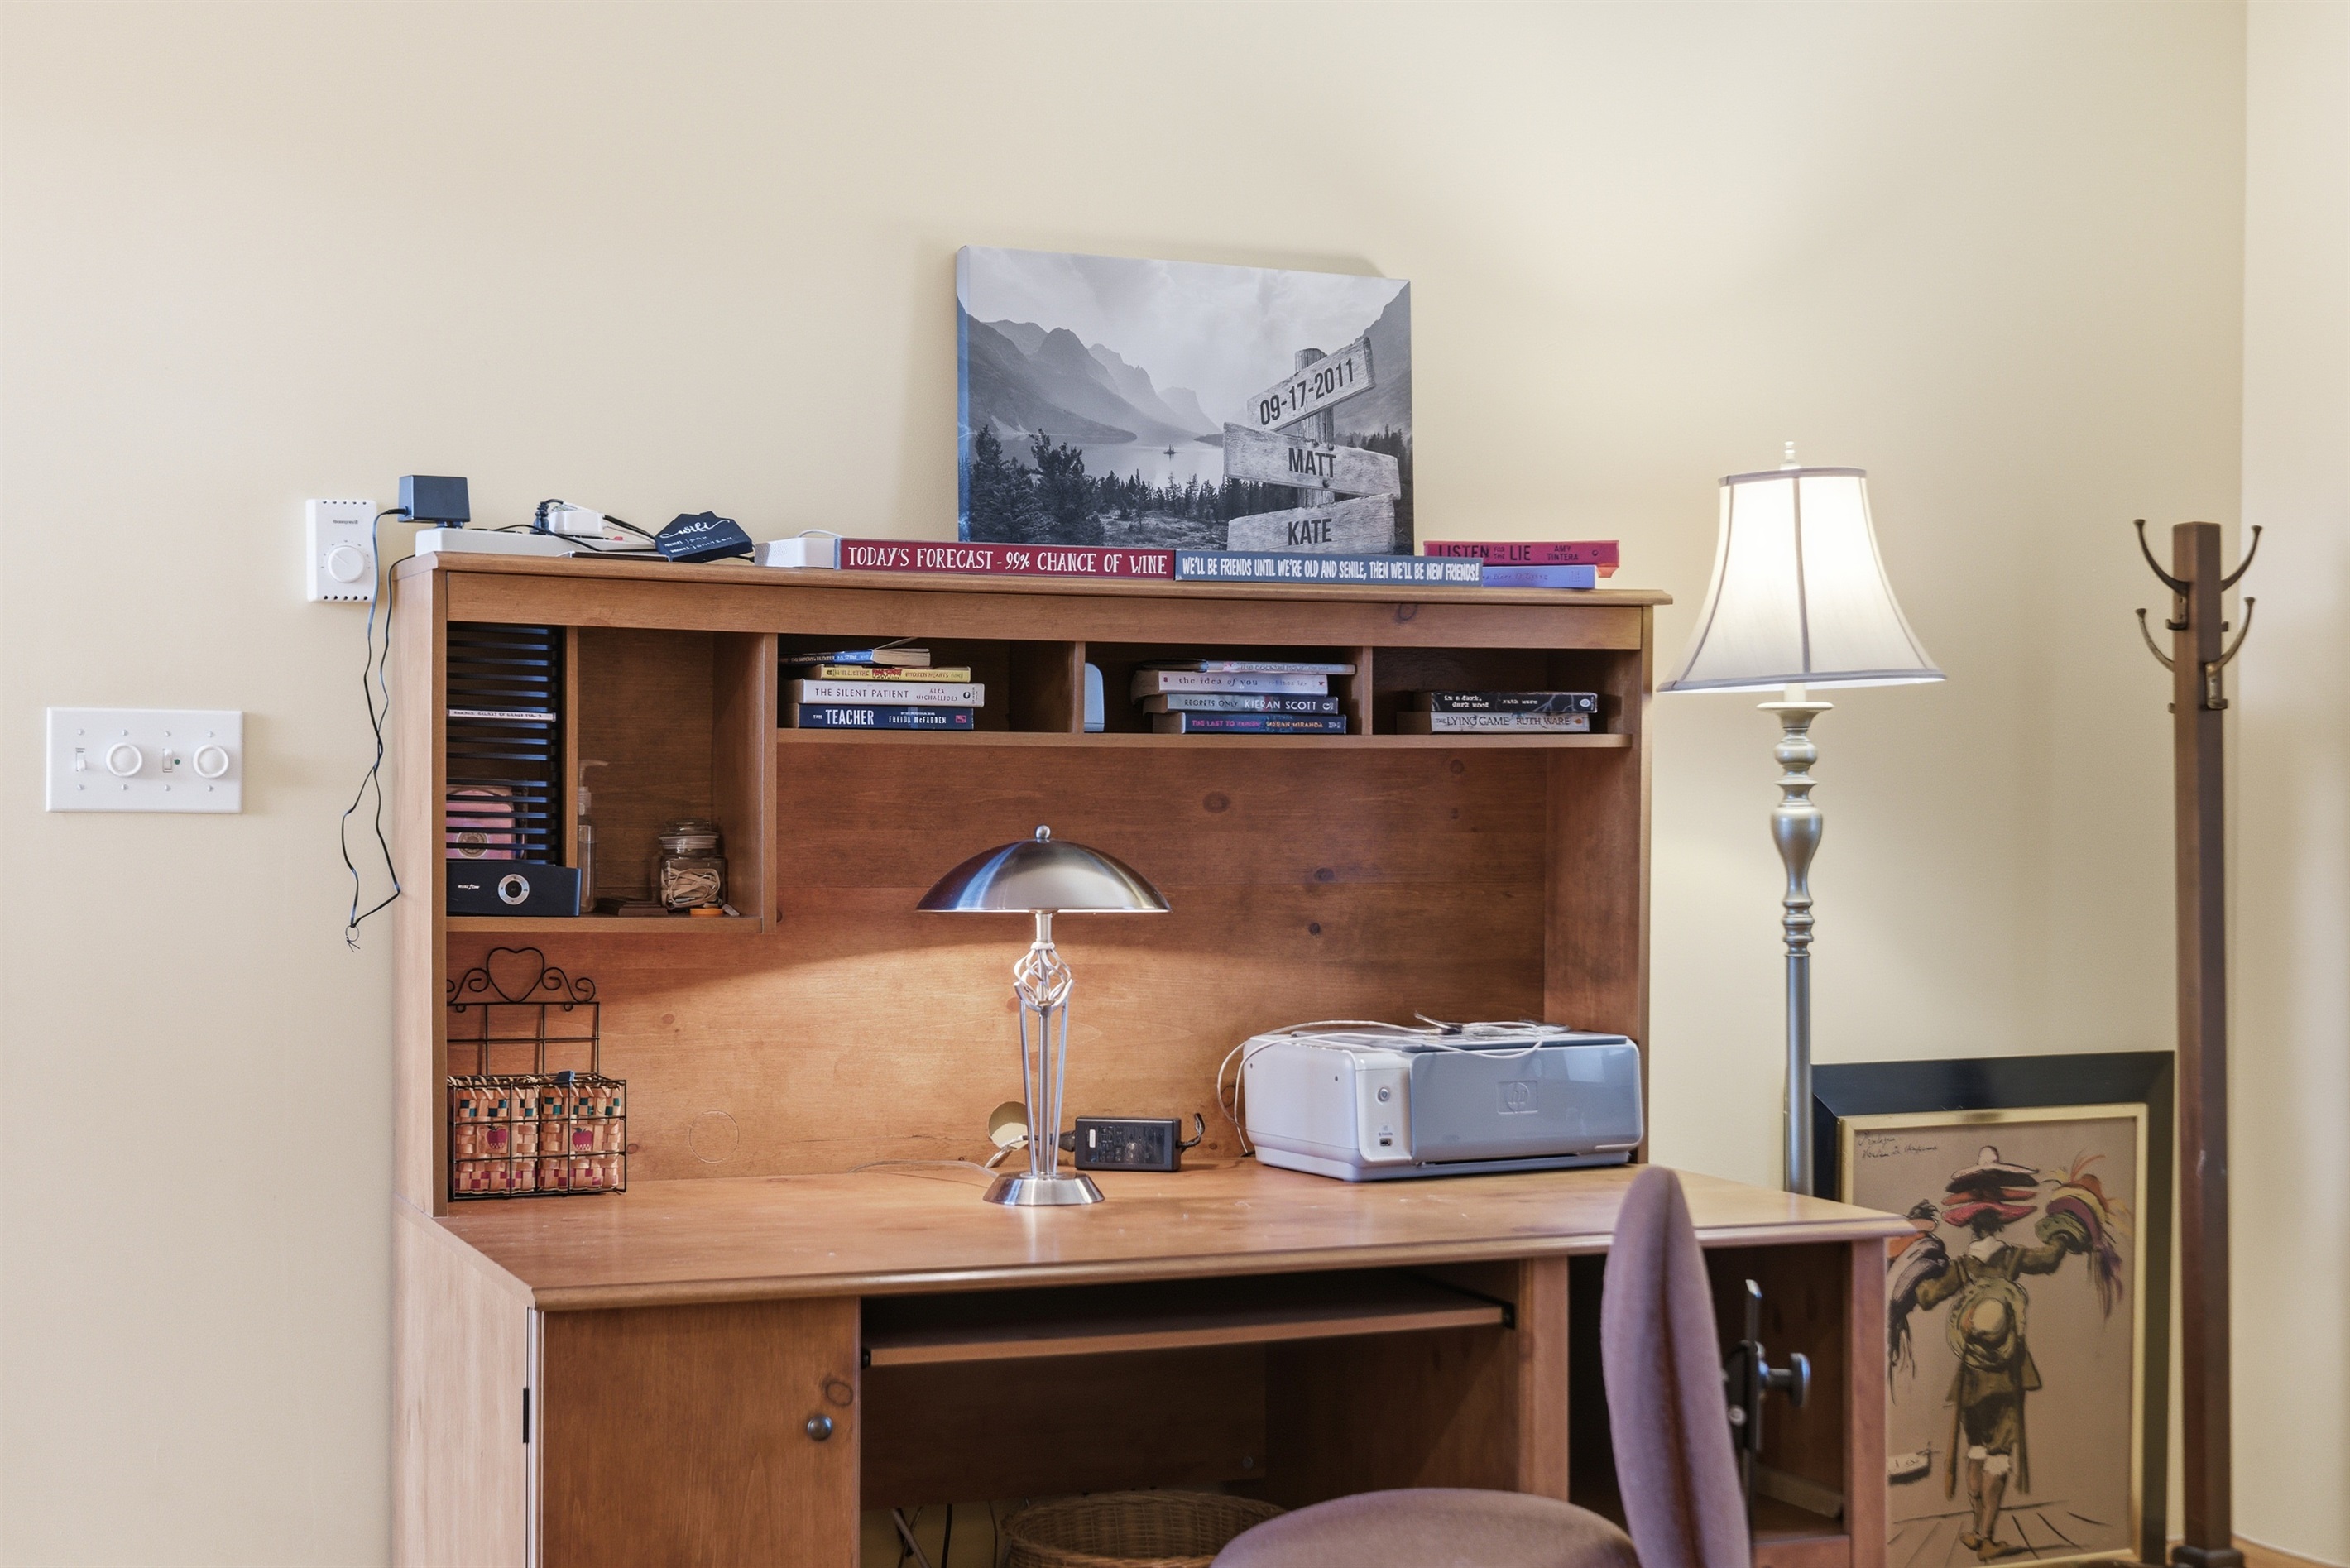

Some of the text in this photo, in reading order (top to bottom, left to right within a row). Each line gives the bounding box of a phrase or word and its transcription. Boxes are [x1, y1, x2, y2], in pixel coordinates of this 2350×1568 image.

[1259, 357, 1354, 425] 09-17-2011
[1288, 447, 1336, 478] MATT
[1288, 518, 1332, 546] KATE
[848, 546, 909, 567] TODAY'S
[916, 547, 994, 569] FORECAST
[1005, 551, 1030, 570] 99%
[1036, 552, 1096, 573] CHANCE
[1103, 554, 1122, 573] OF
[1129, 555, 1168, 574] WINE
[1438, 545, 1489, 558] LISTEN
[1510, 545, 1532, 561] LIE
[1182, 556, 1206, 575] WE'LL
[1207, 558, 1217, 575] BE
[1221, 558, 1252, 576] FRIENDS
[1254, 559, 1276, 577] UNTIL
[1278, 559, 1302, 578] WE'RE
[1304, 559, 1318, 578] OLD
[1321, 560, 1337, 578] AND
[1339, 560, 1367, 580] SENILE,
[1369, 561, 1388, 579] THEN
[1390, 562, 1412, 579] WE'LL
[1414, 563, 1424, 580] BE
[1426, 563, 1444, 581] NEW
[1445, 563, 1480, 582] FRIENDS!
[1200, 677, 1222, 685] idea
[1226, 678, 1238, 688] of
[1240, 679, 1259, 688] you
[815, 688, 909, 698] THE SILENT PATIENT
[1244, 699, 1316, 710] KIERAN SCOTT
[825, 709, 875, 726] TEACHER
[888, 715, 947, 725] FREIDA McFADDEN
[1446, 716, 1477, 726] LYING
[1479, 716, 1509, 726] GAME
[1516, 717, 1571, 725] RUTH WARE
